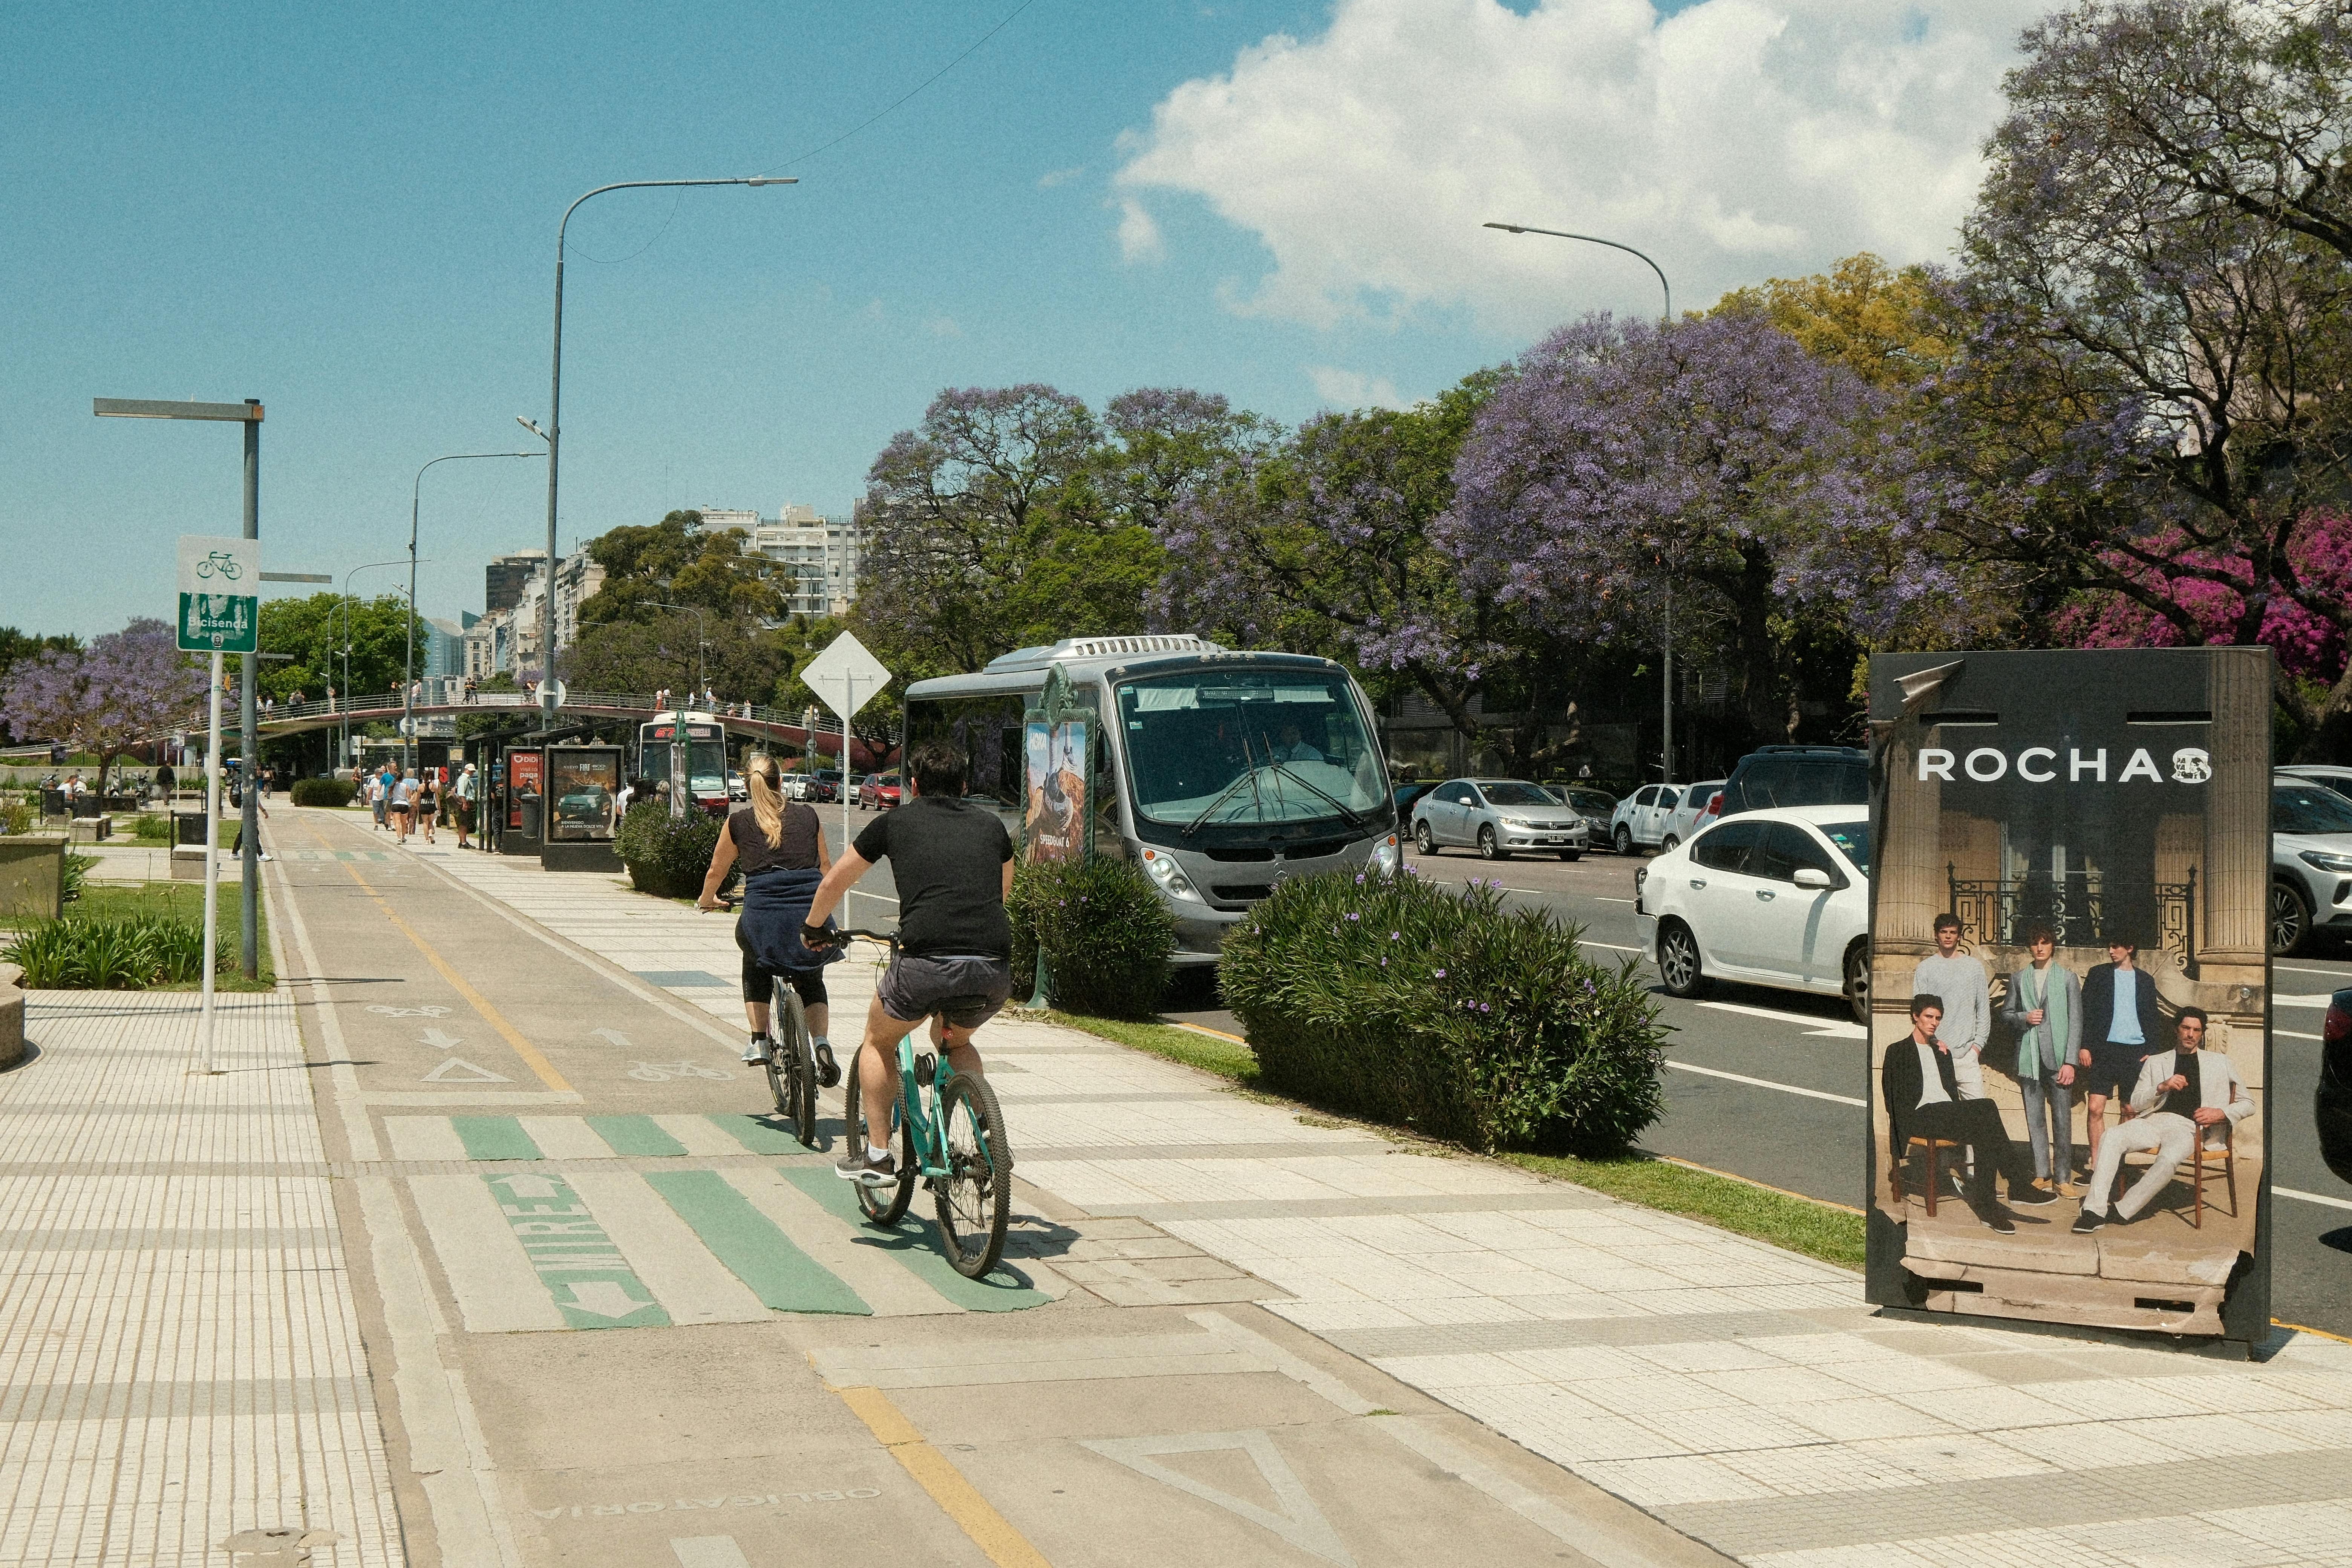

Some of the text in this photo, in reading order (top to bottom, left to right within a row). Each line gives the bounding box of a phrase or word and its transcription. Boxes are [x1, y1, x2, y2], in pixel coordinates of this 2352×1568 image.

[189, 617, 248, 629] Bicisenda
[1029, 732, 1047, 750] HOKA
[1919, 747, 2212, 784] ROCHAS
[1040, 834, 1069, 848] SPEEDGOAT 6
[501, 1204, 633, 1272] MIRE
[529, 1488, 882, 1519] OBLIGATORIA
